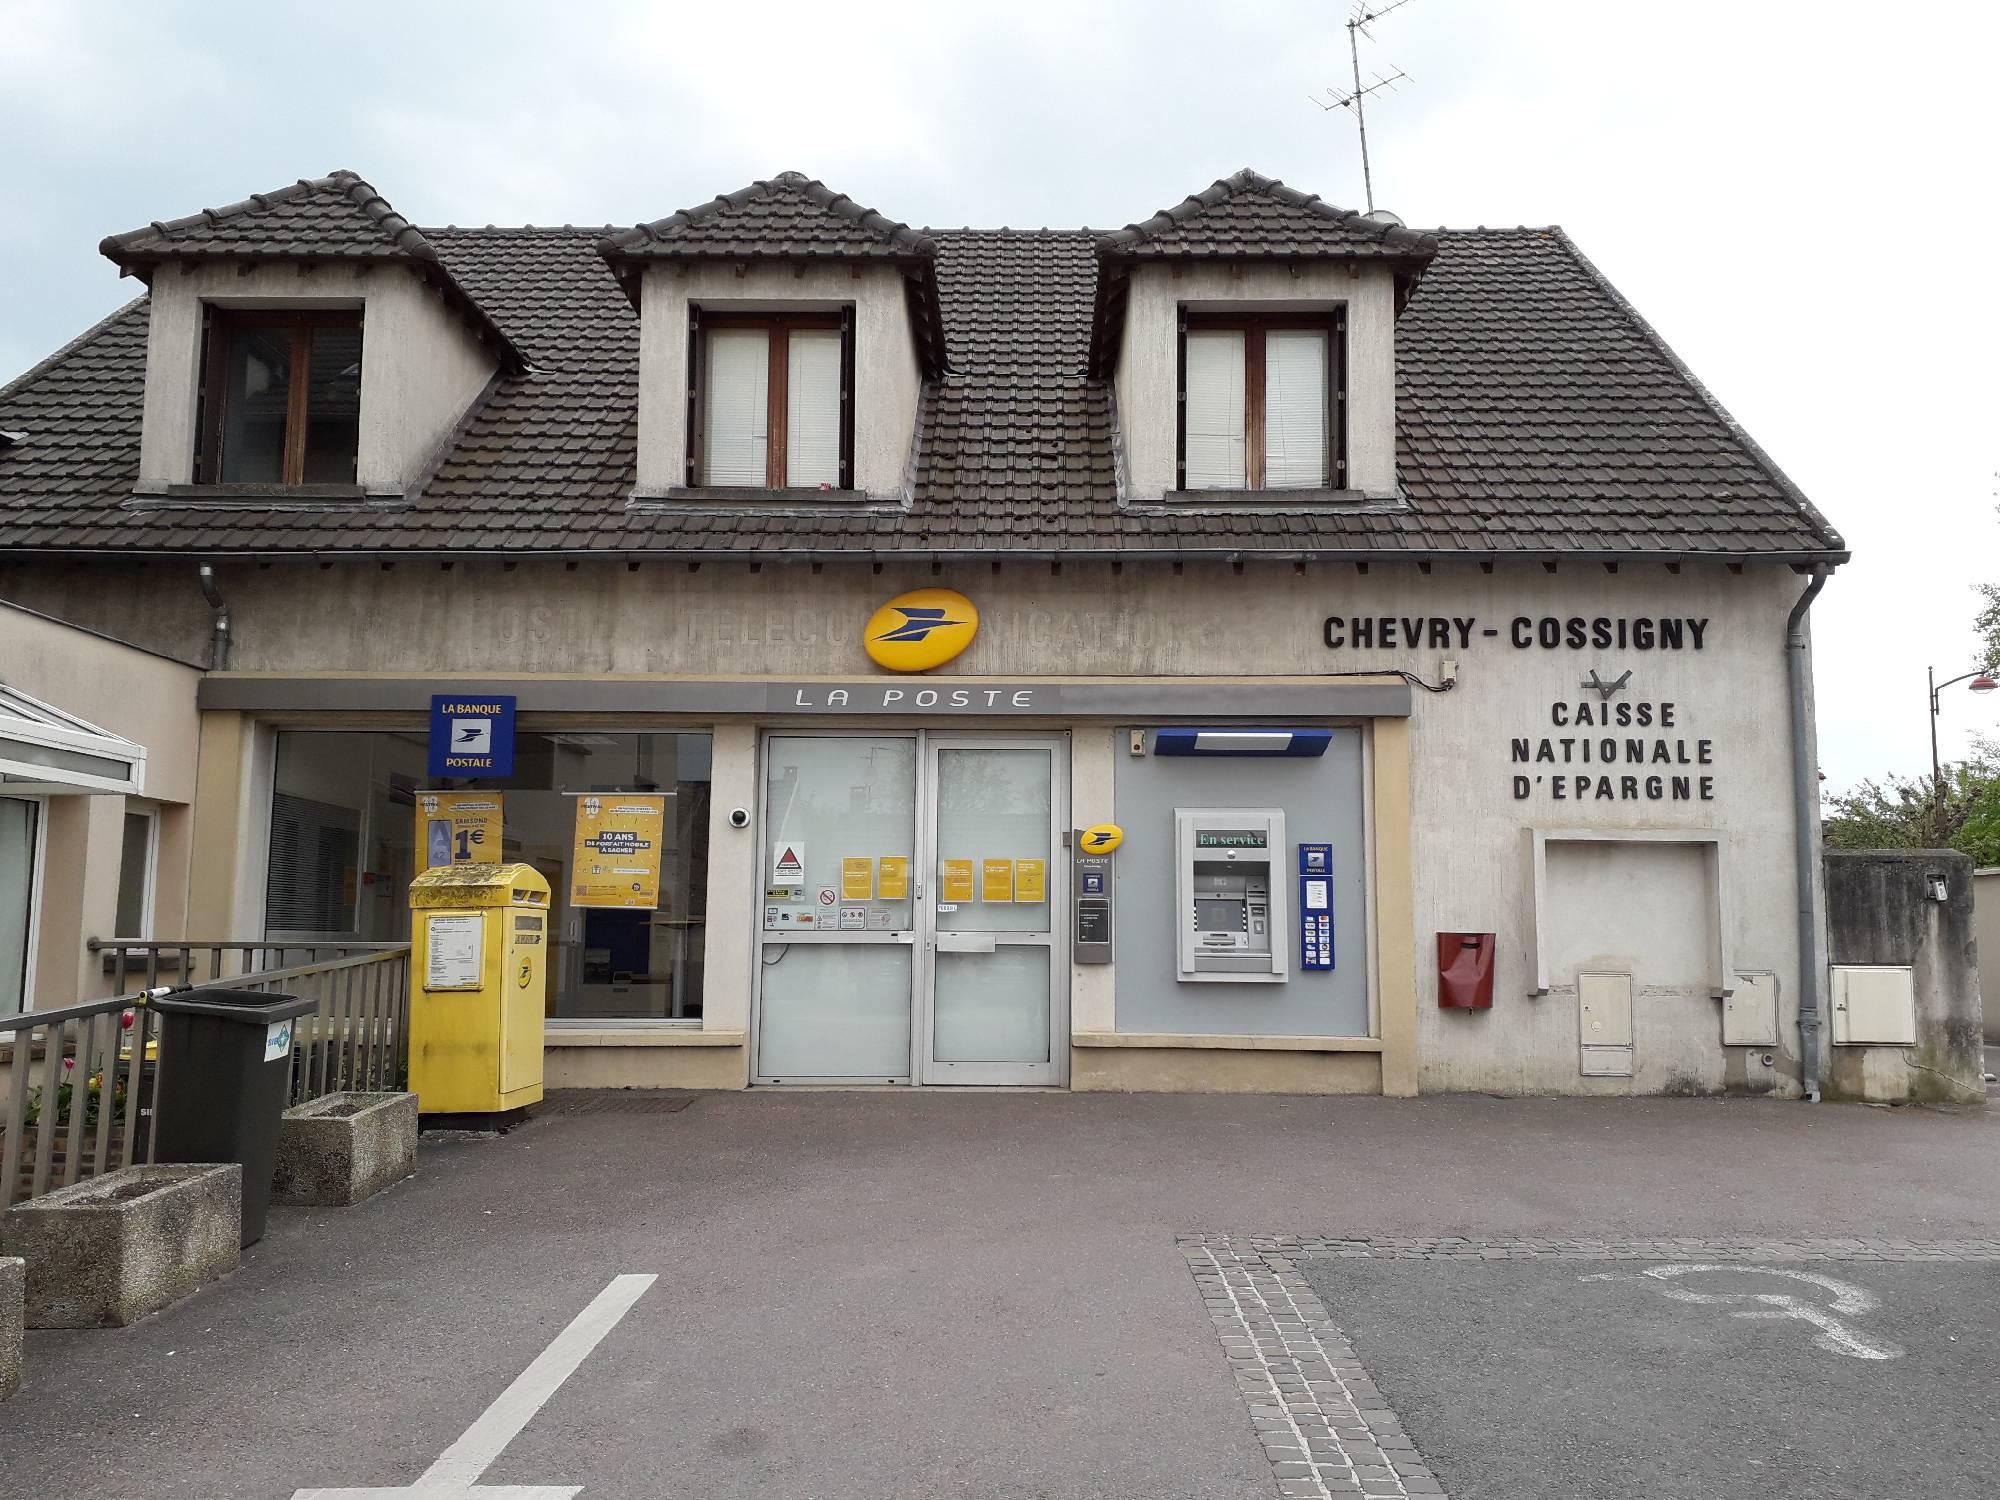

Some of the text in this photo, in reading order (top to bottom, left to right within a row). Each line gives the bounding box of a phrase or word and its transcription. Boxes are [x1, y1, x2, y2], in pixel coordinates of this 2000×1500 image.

[793, 688, 1033, 708] LA POSTE
[442, 703, 502, 716] LA BANQUE
[1551, 702, 1676, 727] CAISSE
[1511, 738, 1713, 764] NATIONALE
[446, 758, 493, 768] POSTALE
[1513, 775, 1715, 801] D'EPARGNE
[602, 833, 634, 841] 10 ANS
[1200, 833, 1264, 845] En service
